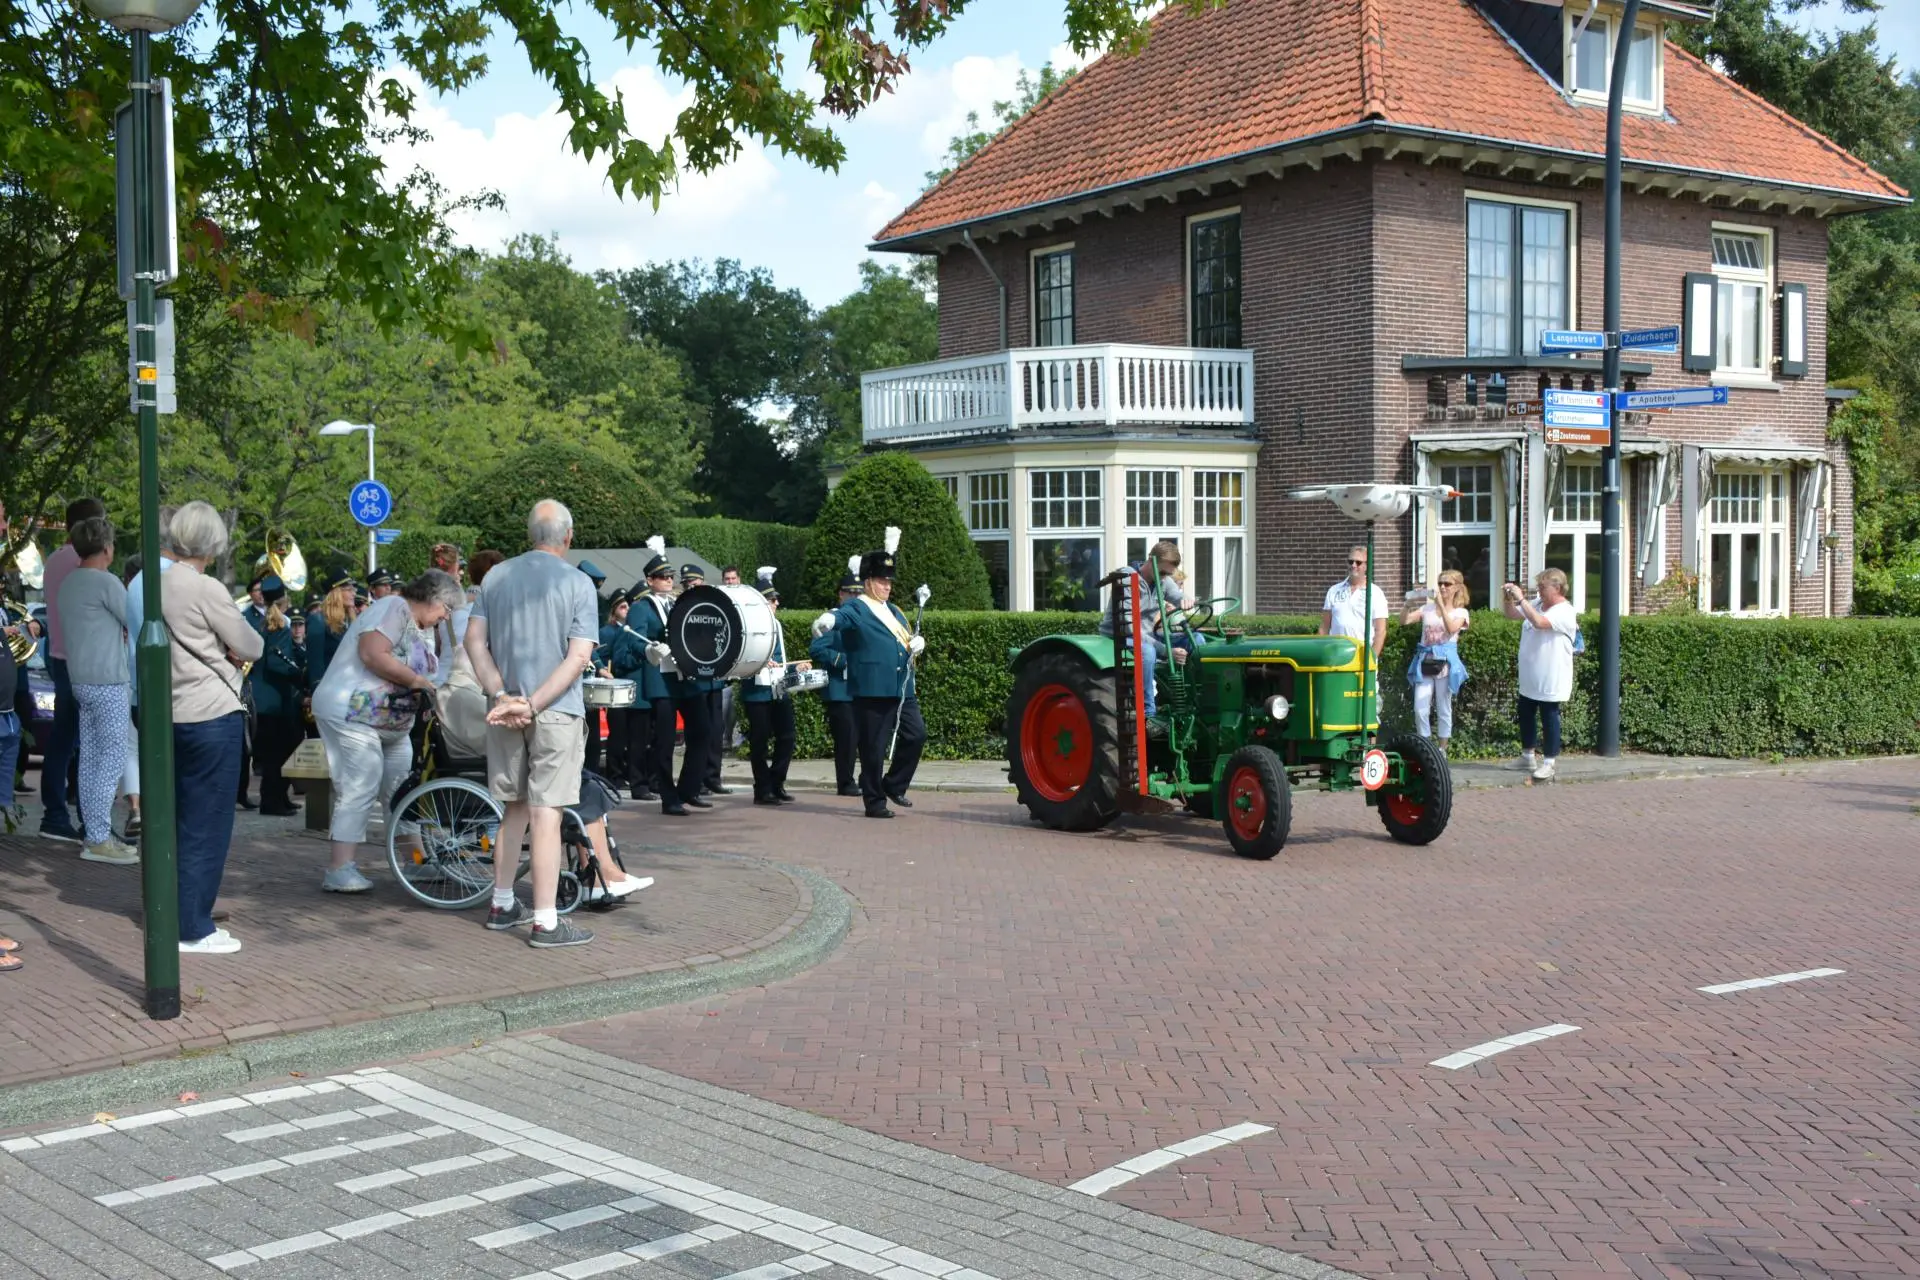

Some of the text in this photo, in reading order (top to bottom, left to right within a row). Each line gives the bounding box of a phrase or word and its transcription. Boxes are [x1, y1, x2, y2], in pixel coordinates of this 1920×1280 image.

[1551, 334, 1597, 344] Langestraat
[1624, 331, 1674, 343] Zuiderhagen
[1638, 395, 1676, 404] Apotheek
[688, 616, 723, 625] AMICITIA
[1364, 761, 1378, 778] 16
